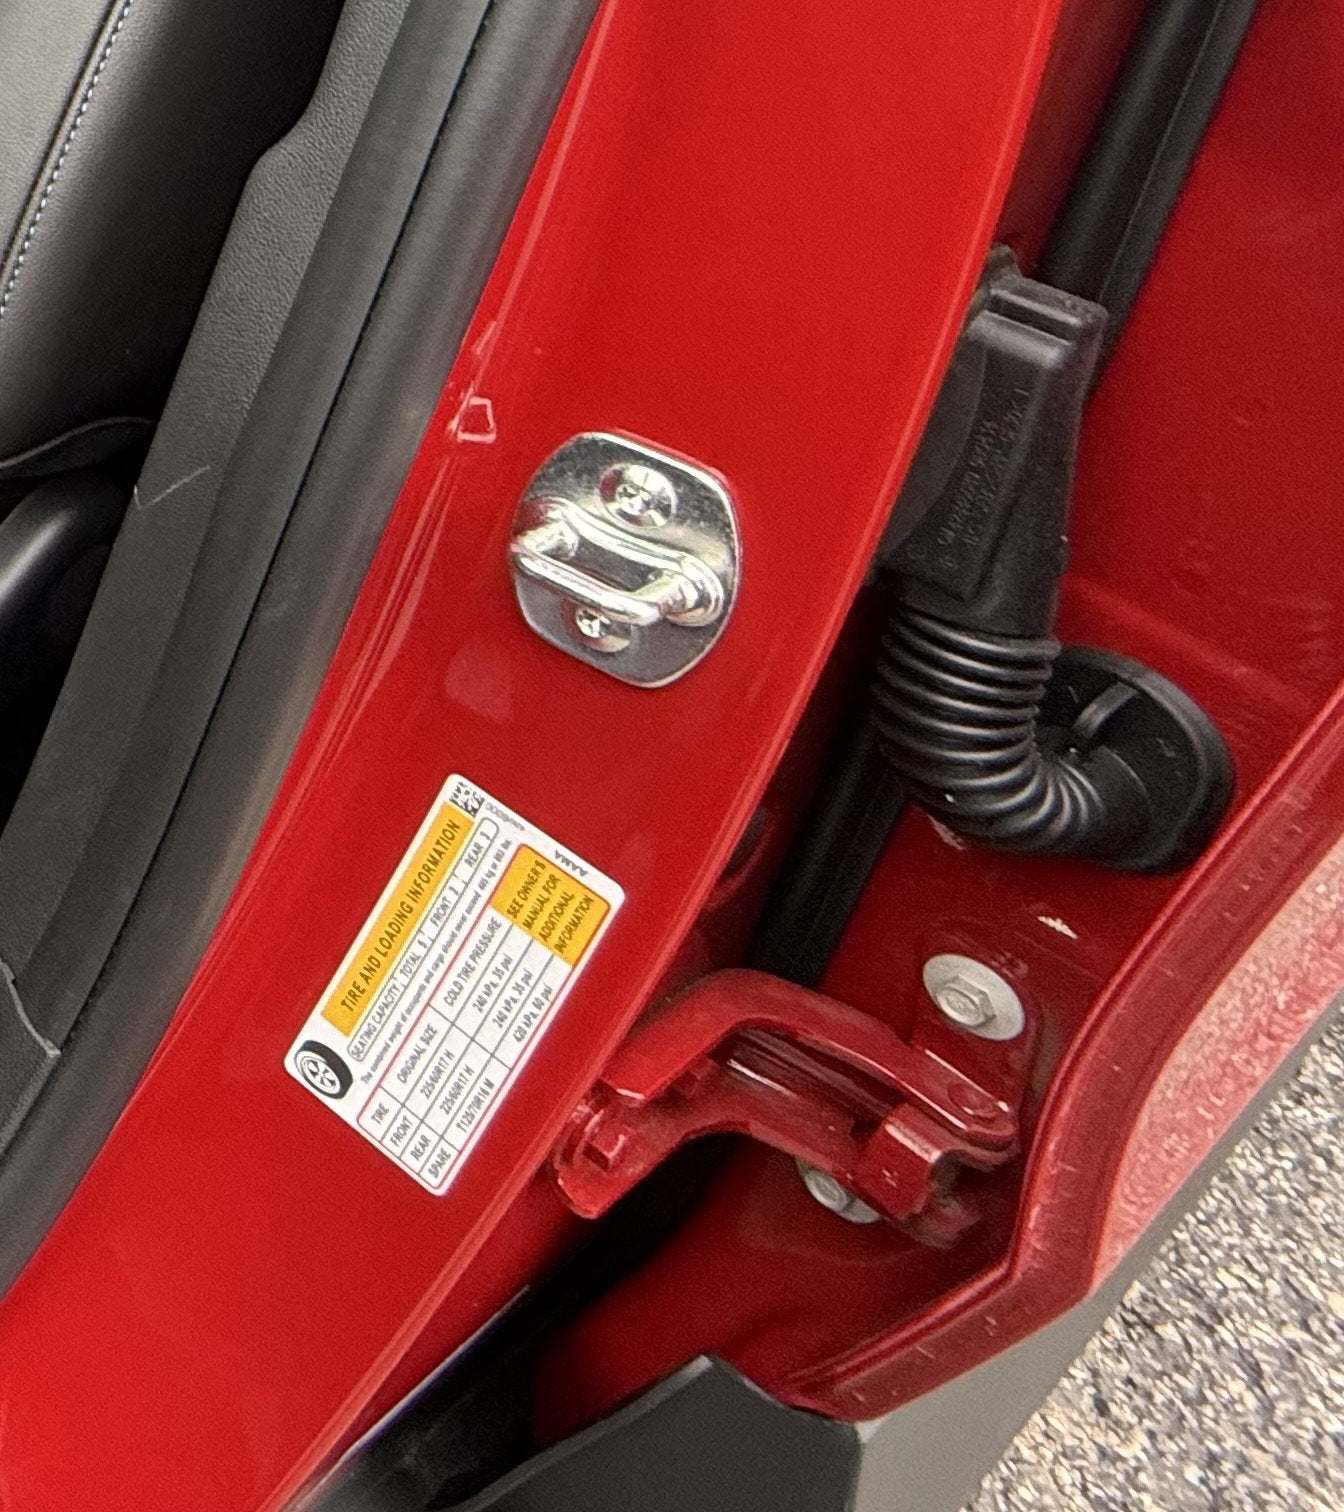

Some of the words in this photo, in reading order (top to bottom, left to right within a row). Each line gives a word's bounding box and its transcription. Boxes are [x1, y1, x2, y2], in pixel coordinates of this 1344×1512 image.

[464, 841, 484, 868] REAR
[340, 980, 367, 1012] TIRE
[359, 954, 381, 986] AND
[374, 900, 414, 958] LOADING
[405, 819, 461, 904] INFORMATION
[429, 895, 451, 928] FRONT
[506, 897, 524, 920] SEE
[522, 894, 550, 931] MANUAL
[541, 873, 561, 896] FOR
[538, 891, 575, 942] ADDITIONAL
[553, 894, 595, 954] INFORMATION
[399, 952, 422, 978] TOTAL
[443, 980, 464, 1007] COLD
[456, 960, 476, 983] TIRE
[468, 916, 503, 965] PRESSURE
[349, 1022, 377, 1060] SEATING
[371, 983, 401, 1025] CAPACITY
[396, 1044, 426, 1084] ORIGINAL
[419, 1023, 438, 1046] SIZE
[370, 1102, 389, 1125] TIRE
[389, 1115, 413, 1148] FRONT
[410, 1134, 431, 1161] REAR
[427, 1147, 452, 1179] SPARE
